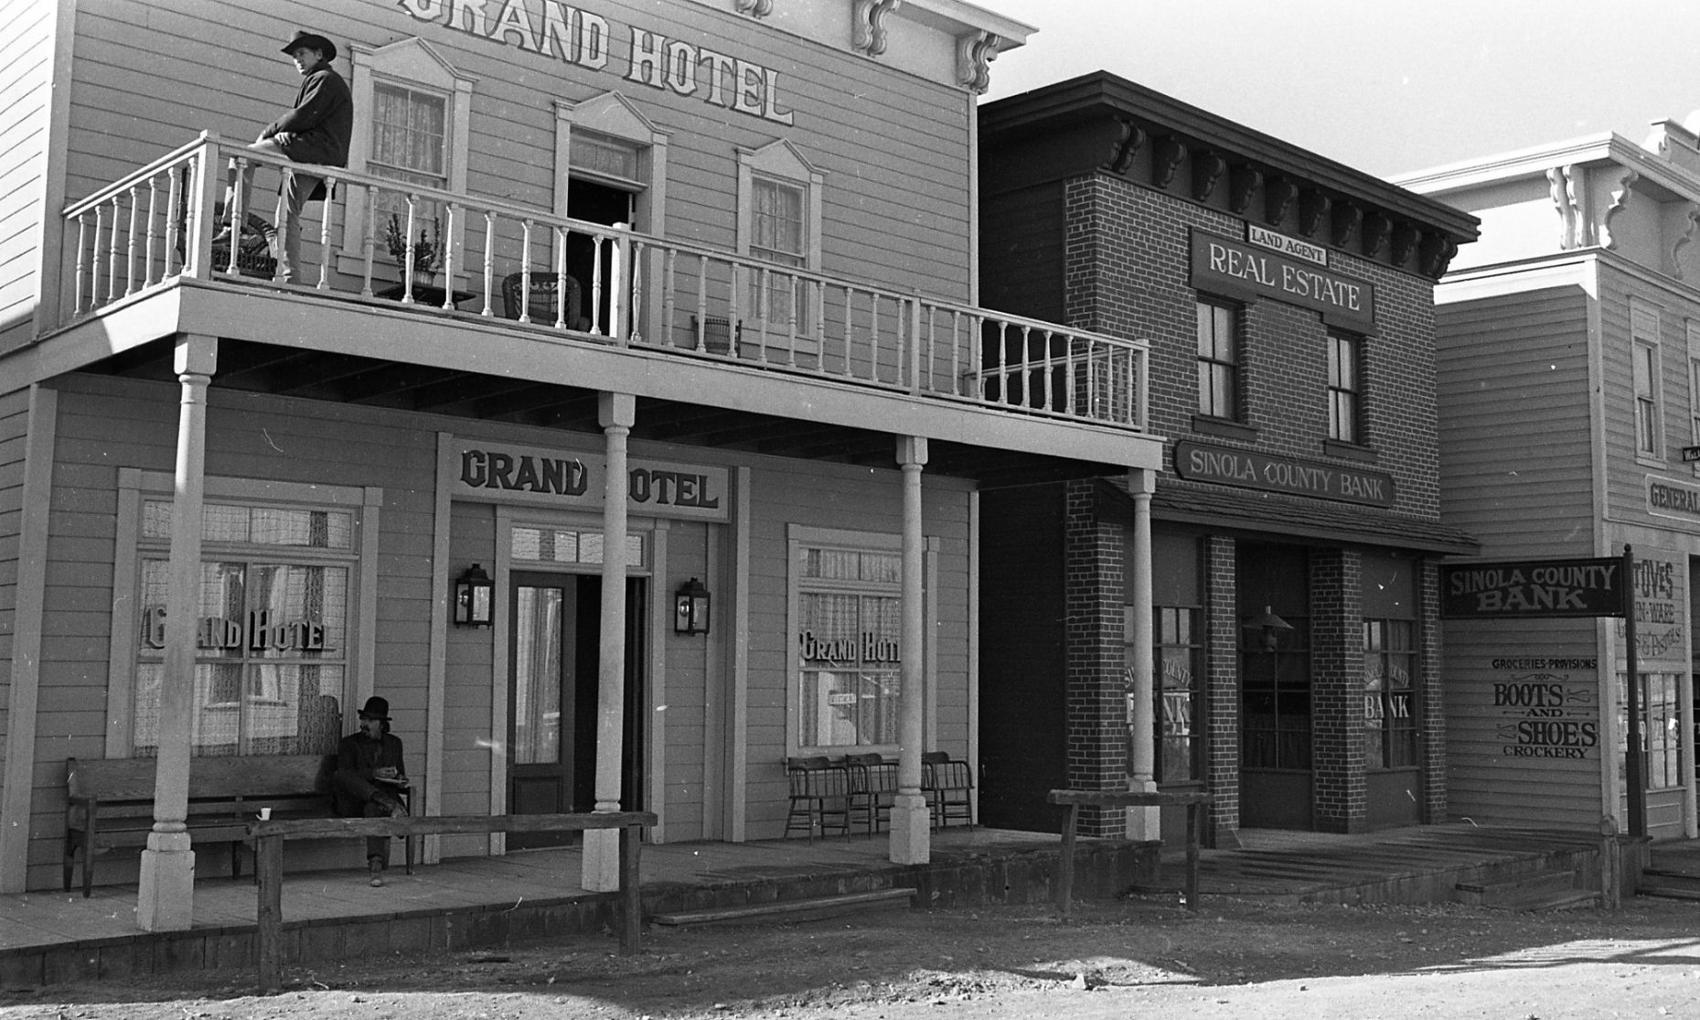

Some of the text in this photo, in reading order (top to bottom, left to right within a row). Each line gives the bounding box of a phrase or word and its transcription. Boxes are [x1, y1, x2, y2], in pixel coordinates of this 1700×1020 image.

[622, 25, 794, 127] HOTEL
[1251, 228, 1324, 263] LAND AGENT
[1209, 243, 1361, 311] REAL ESTATE
[460, 450, 719, 509] GRAND OTEL
[1190, 449, 1384, 500] SINOLA COUNTY BANK
[1451, 564, 1616, 595] SINOLA COUNTY
[1632, 560, 1672, 599] TOVES
[1477, 584, 1588, 611] BANK
[144, 605, 337, 651] GAND HOTEL
[800, 630, 900, 664] GRAND HOT
[1366, 695, 1409, 719] BANK
[1493, 683, 1564, 708] BOOTS
[1526, 709, 1563, 718] AND
[1517, 721, 1598, 747] SHOES
[1503, 746, 1588, 759] CROCKERY
